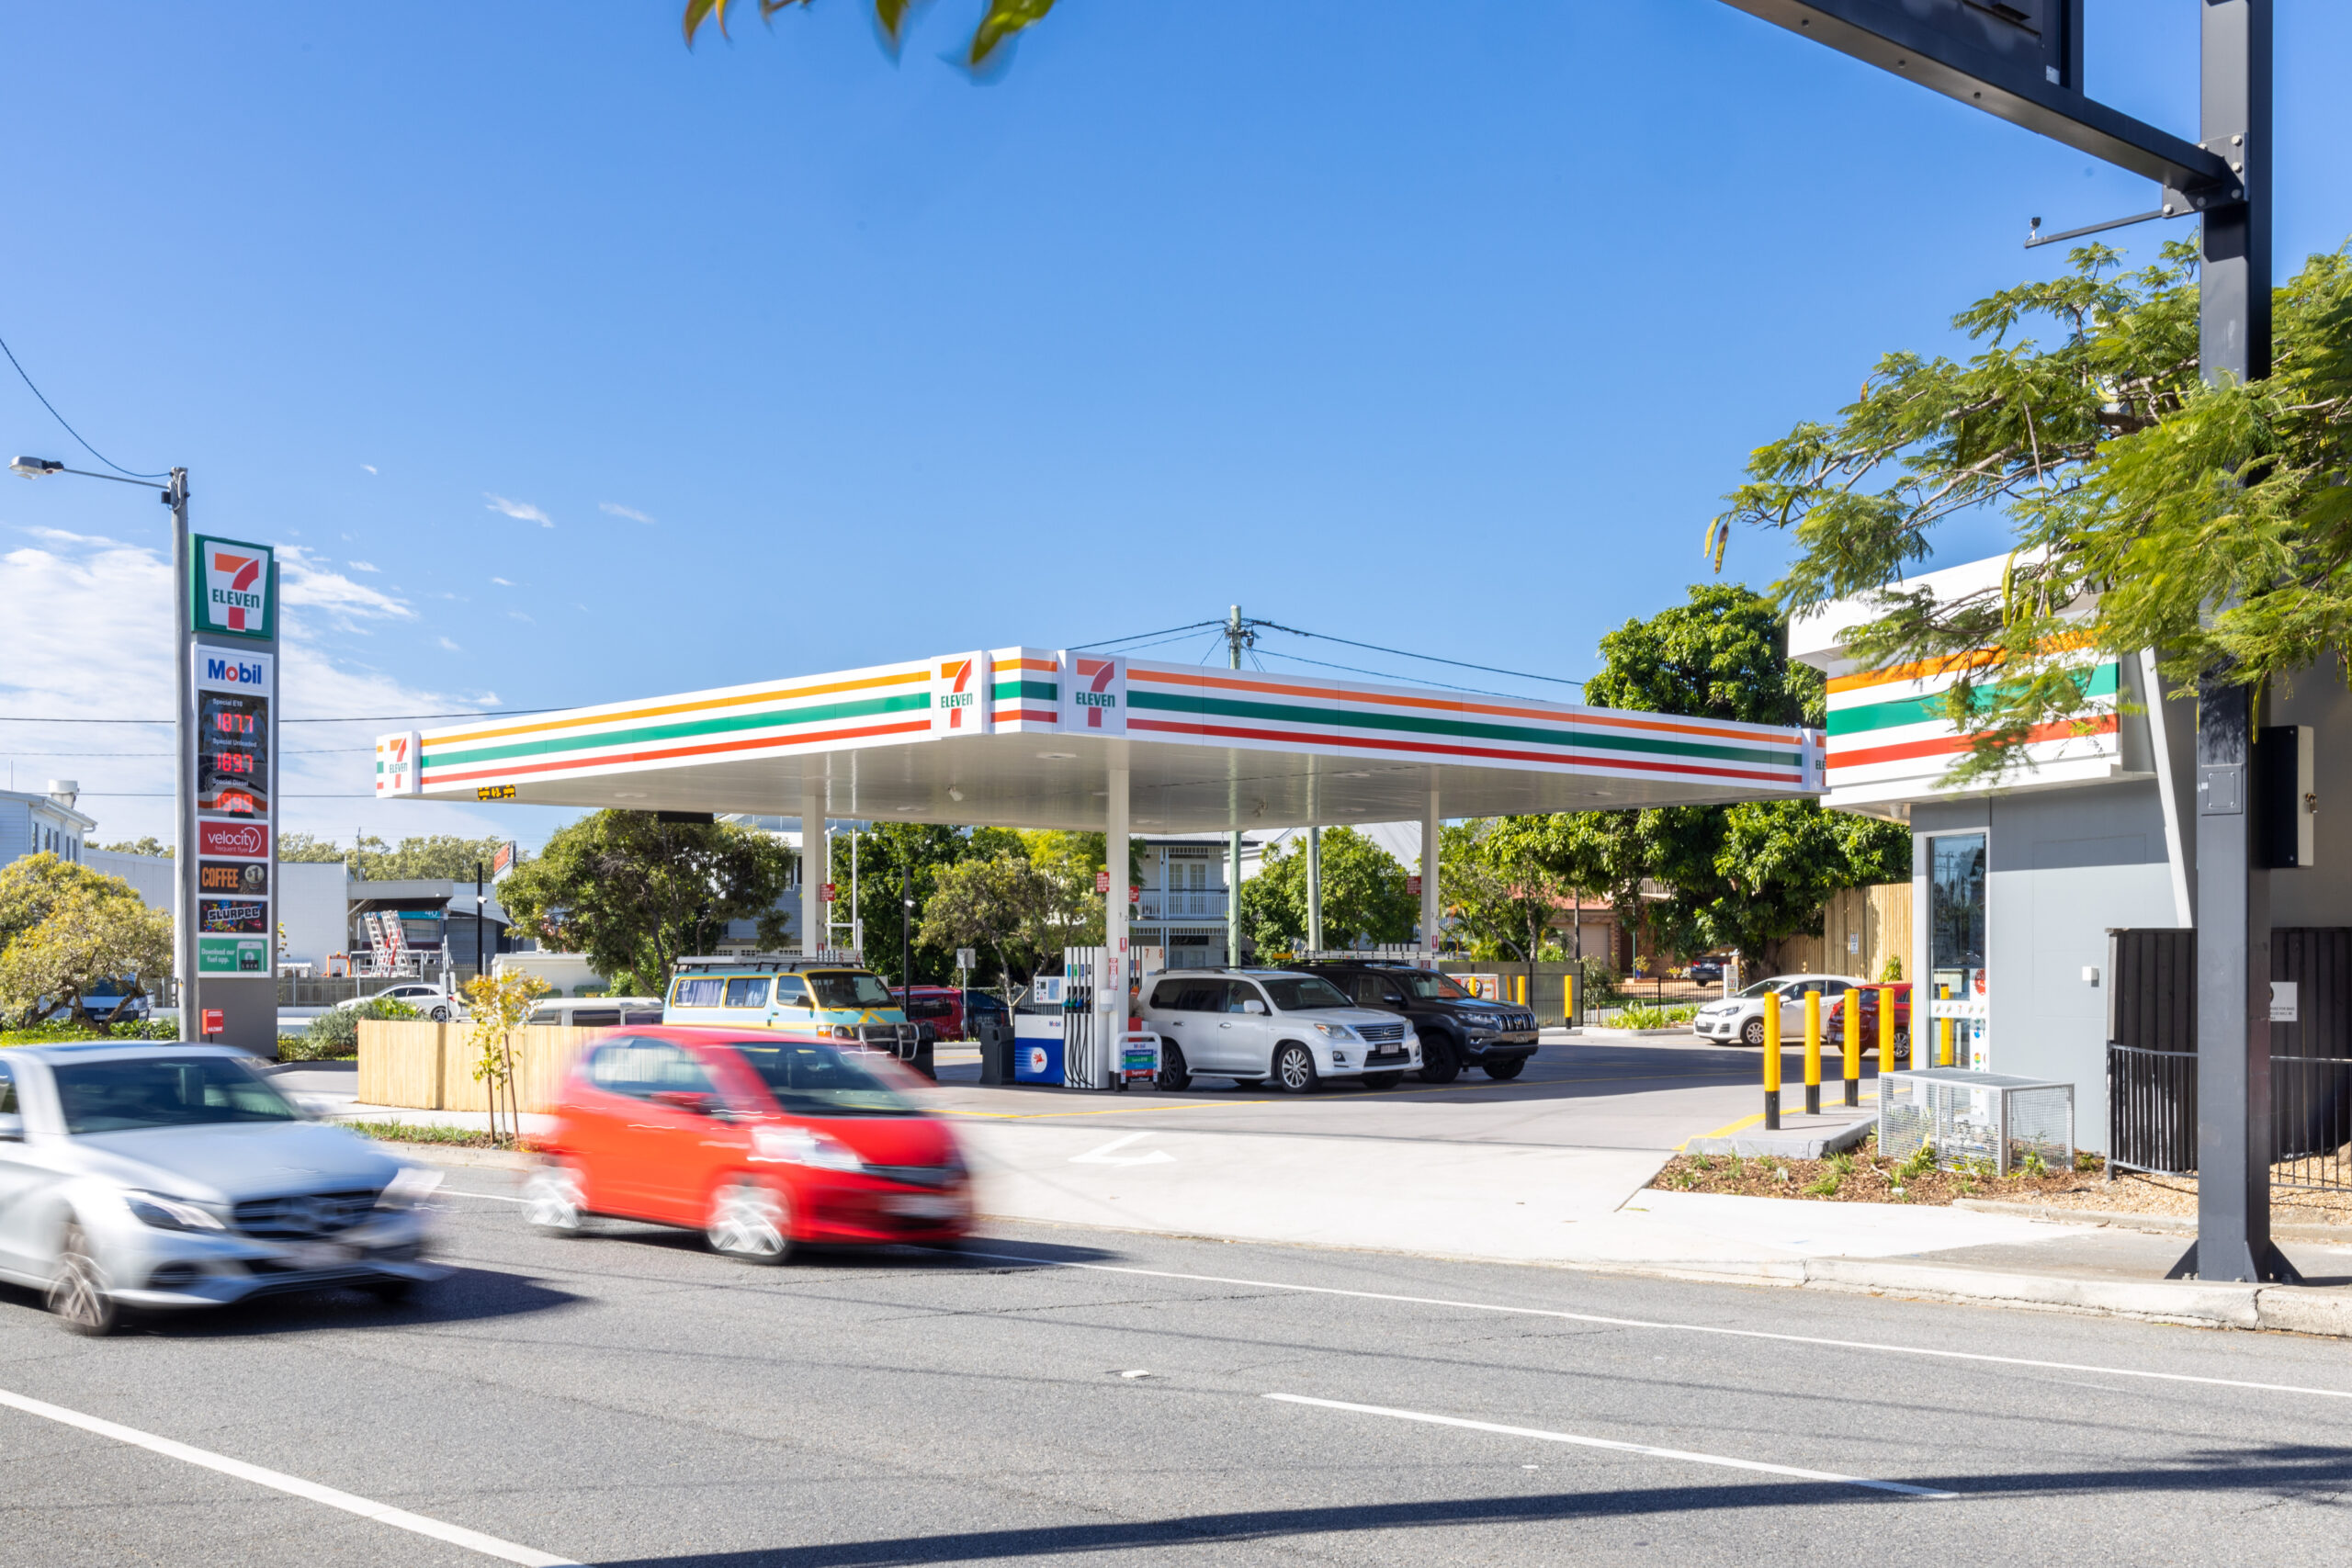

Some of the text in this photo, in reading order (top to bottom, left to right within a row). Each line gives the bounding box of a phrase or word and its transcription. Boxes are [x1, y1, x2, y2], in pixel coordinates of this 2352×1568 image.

[215, 552, 259, 630] 7
[208, 658, 262, 685] Mobil
[212, 698, 232, 706] Special
[941, 659, 972, 728] 7
[1077, 659, 1114, 728] 7
[212, 738, 257, 748] Special Unleaded
[208, 829, 258, 853] velocity
[201, 866, 239, 888] COFFEE
[200, 947, 226, 956] Download
[207, 955, 219, 964] fuel
[1145, 948, 1149, 959] 7
